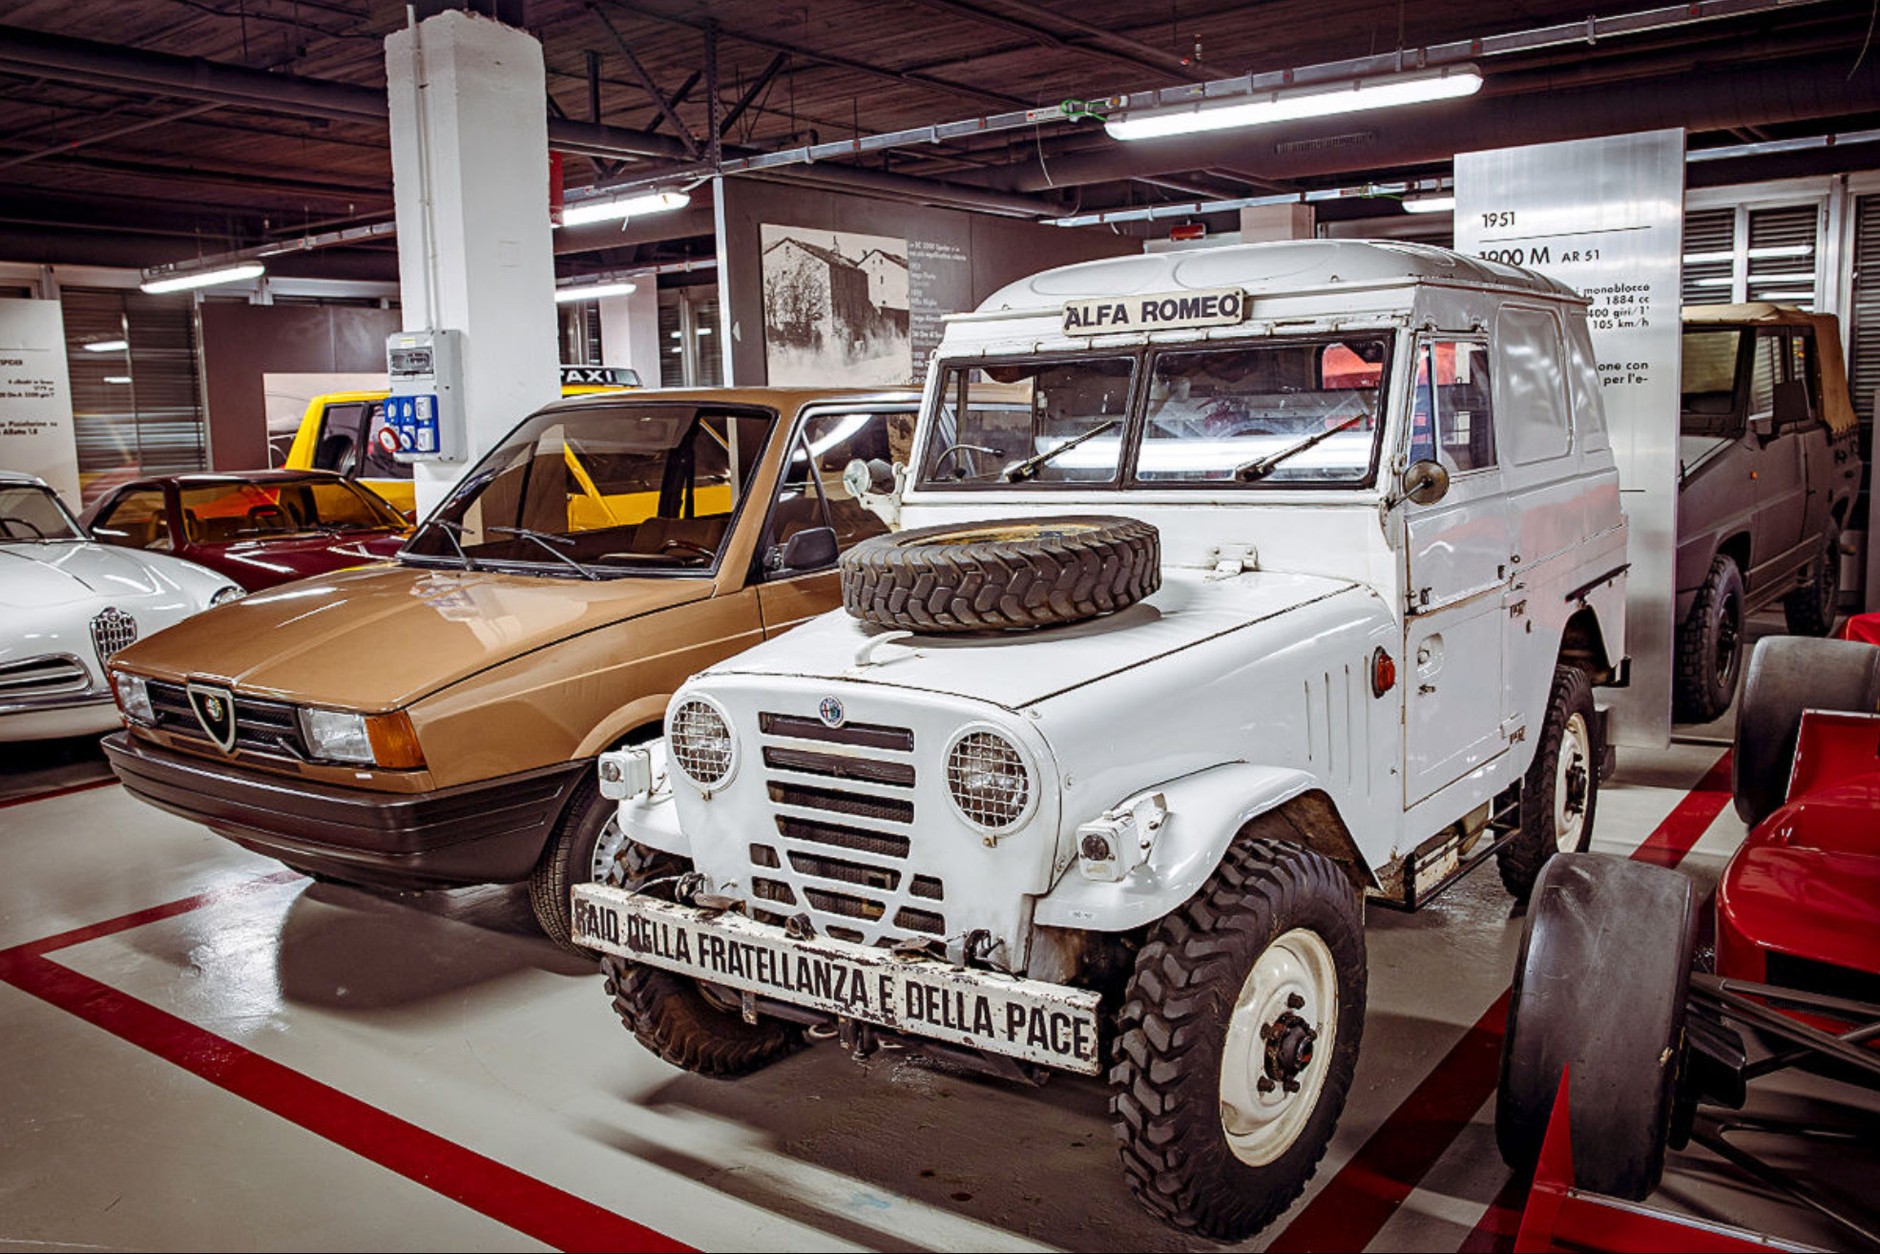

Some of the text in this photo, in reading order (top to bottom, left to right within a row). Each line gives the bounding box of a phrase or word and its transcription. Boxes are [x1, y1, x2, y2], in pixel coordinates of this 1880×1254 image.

[1482, 212, 1515, 228] 1951
[1530, 246, 1550, 265] M
[1561, 249, 1600, 263] AR 51
[1606, 295, 1650, 305] 1884 cc
[1065, 294, 1240, 328] ALFA ROMEO
[1593, 317, 1650, 329] 105 km/h
[1626, 362, 1649, 370] con
[561, 369, 613, 382] AXI
[1604, 377, 1625, 387] per
[574, 898, 1091, 1062] RAID DELLA FRATELLANZA E DELLA PACE
